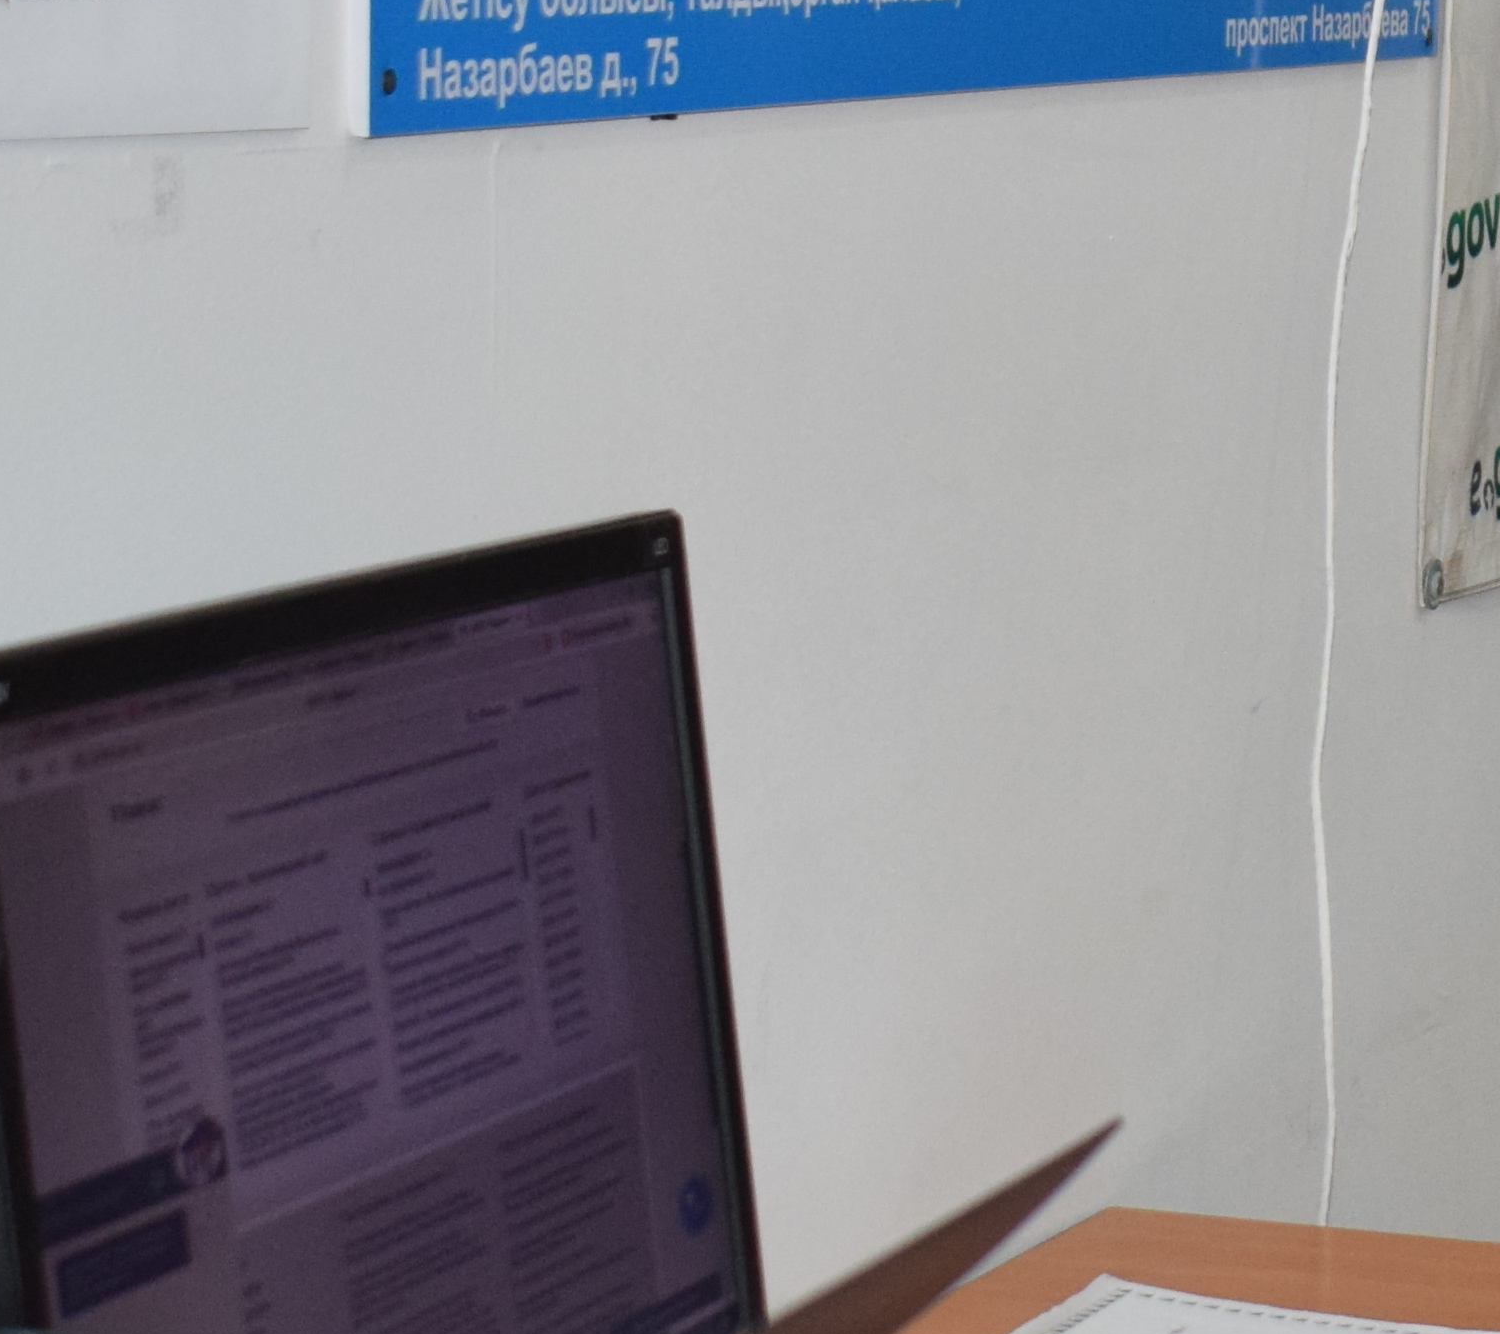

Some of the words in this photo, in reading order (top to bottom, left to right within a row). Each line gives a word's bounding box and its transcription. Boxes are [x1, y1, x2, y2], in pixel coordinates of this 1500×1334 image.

[1225, 13, 1308, 57] проспект
[1312, 0, 1409, 49] Назарбева
[419, 43, 592, 109] Назарбаев
[601, 56, 637, 98] д.,
[647, 36, 679, 87] 75
